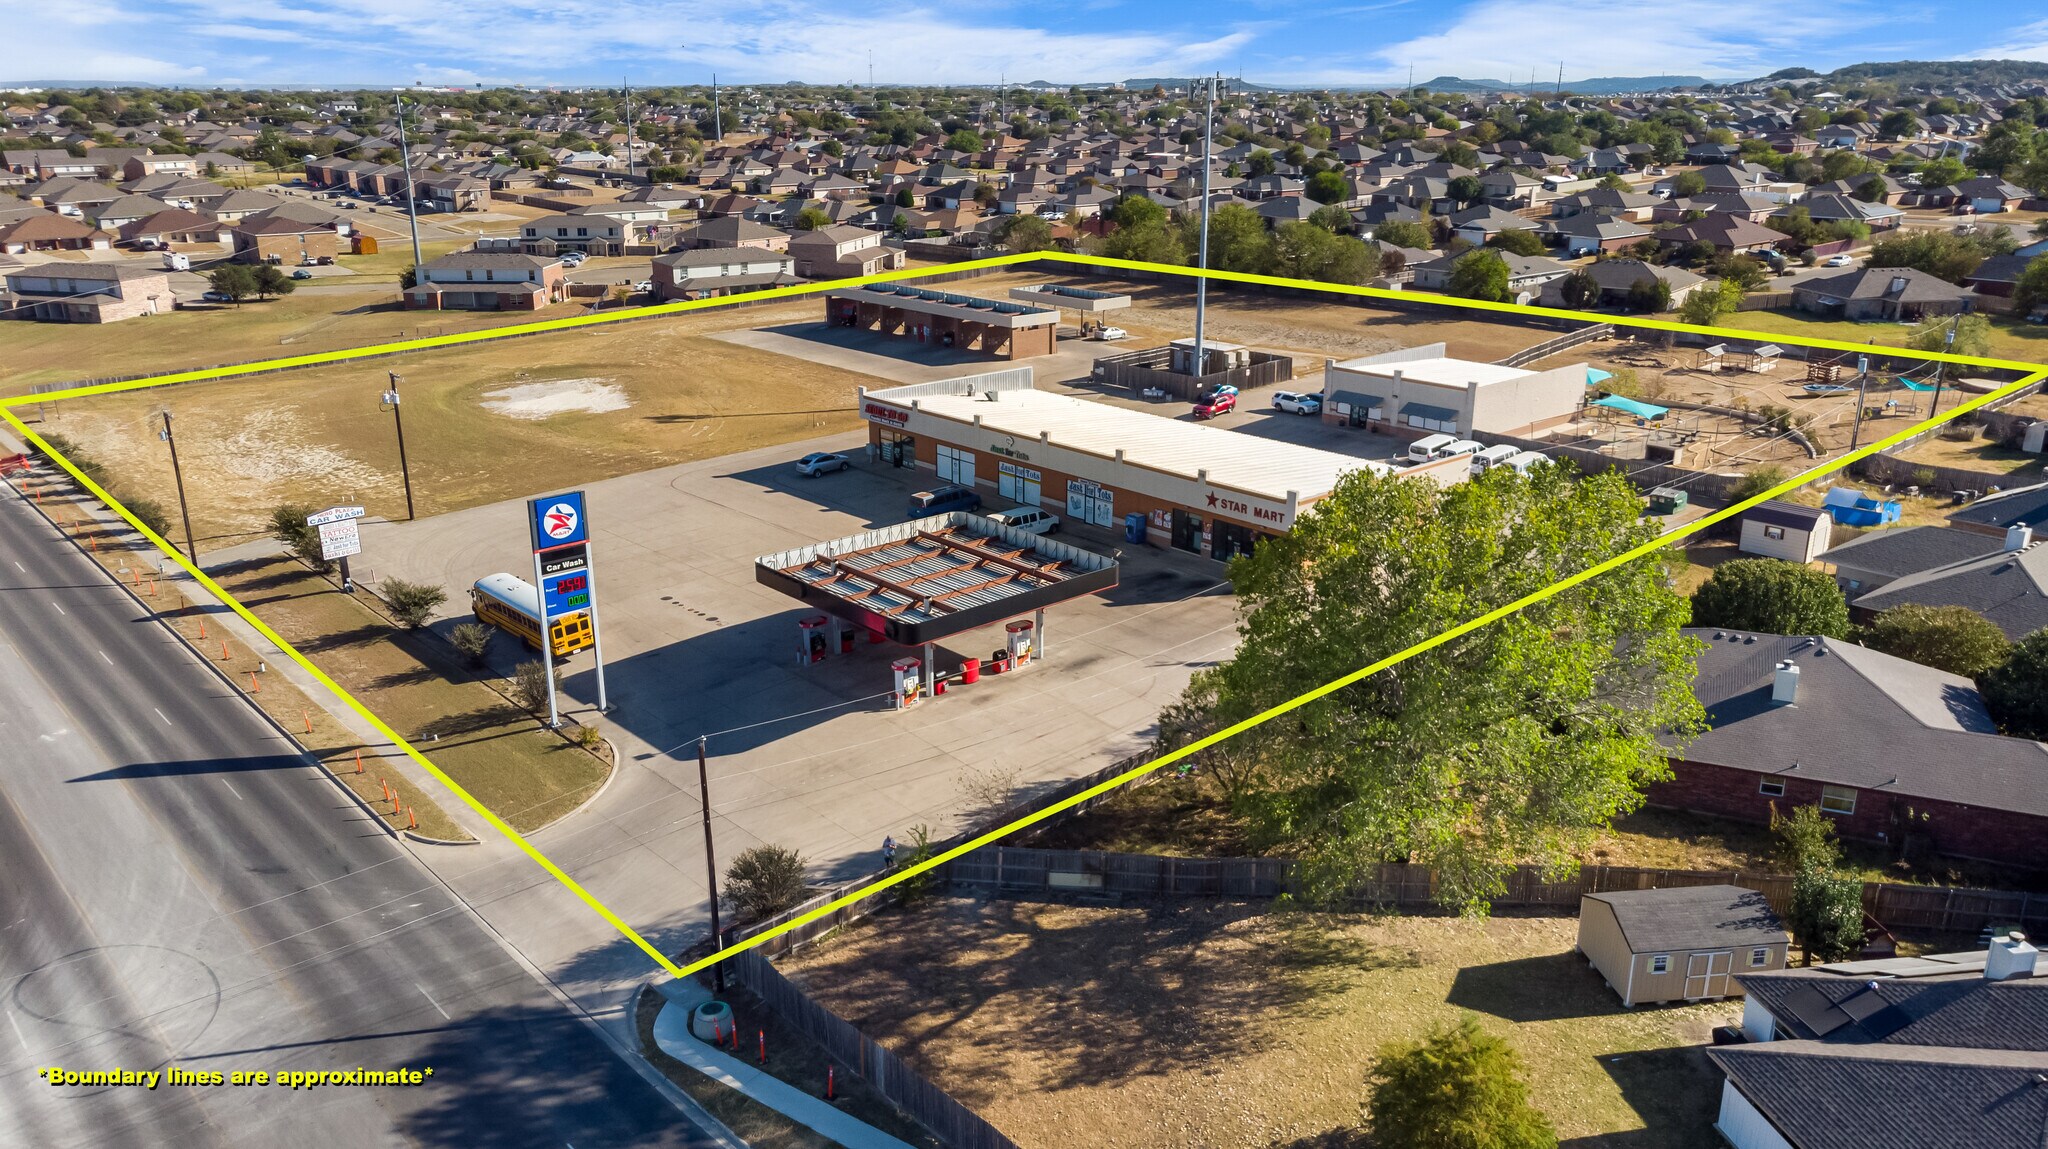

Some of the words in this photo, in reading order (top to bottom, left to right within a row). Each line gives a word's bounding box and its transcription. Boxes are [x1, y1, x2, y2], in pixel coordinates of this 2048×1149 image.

[1026, 470, 1040, 480] Tots
[1097, 488, 1112, 500] Tots
[310, 516, 330, 524] CAR
[335, 510, 363, 520] WASH
[1220, 498, 1248, 514] STAR
[1254, 506, 1285, 524] MART
[322, 526, 355, 538] TATTOO
[546, 562, 560, 572] Car
[562, 558, 584, 568] Wash
